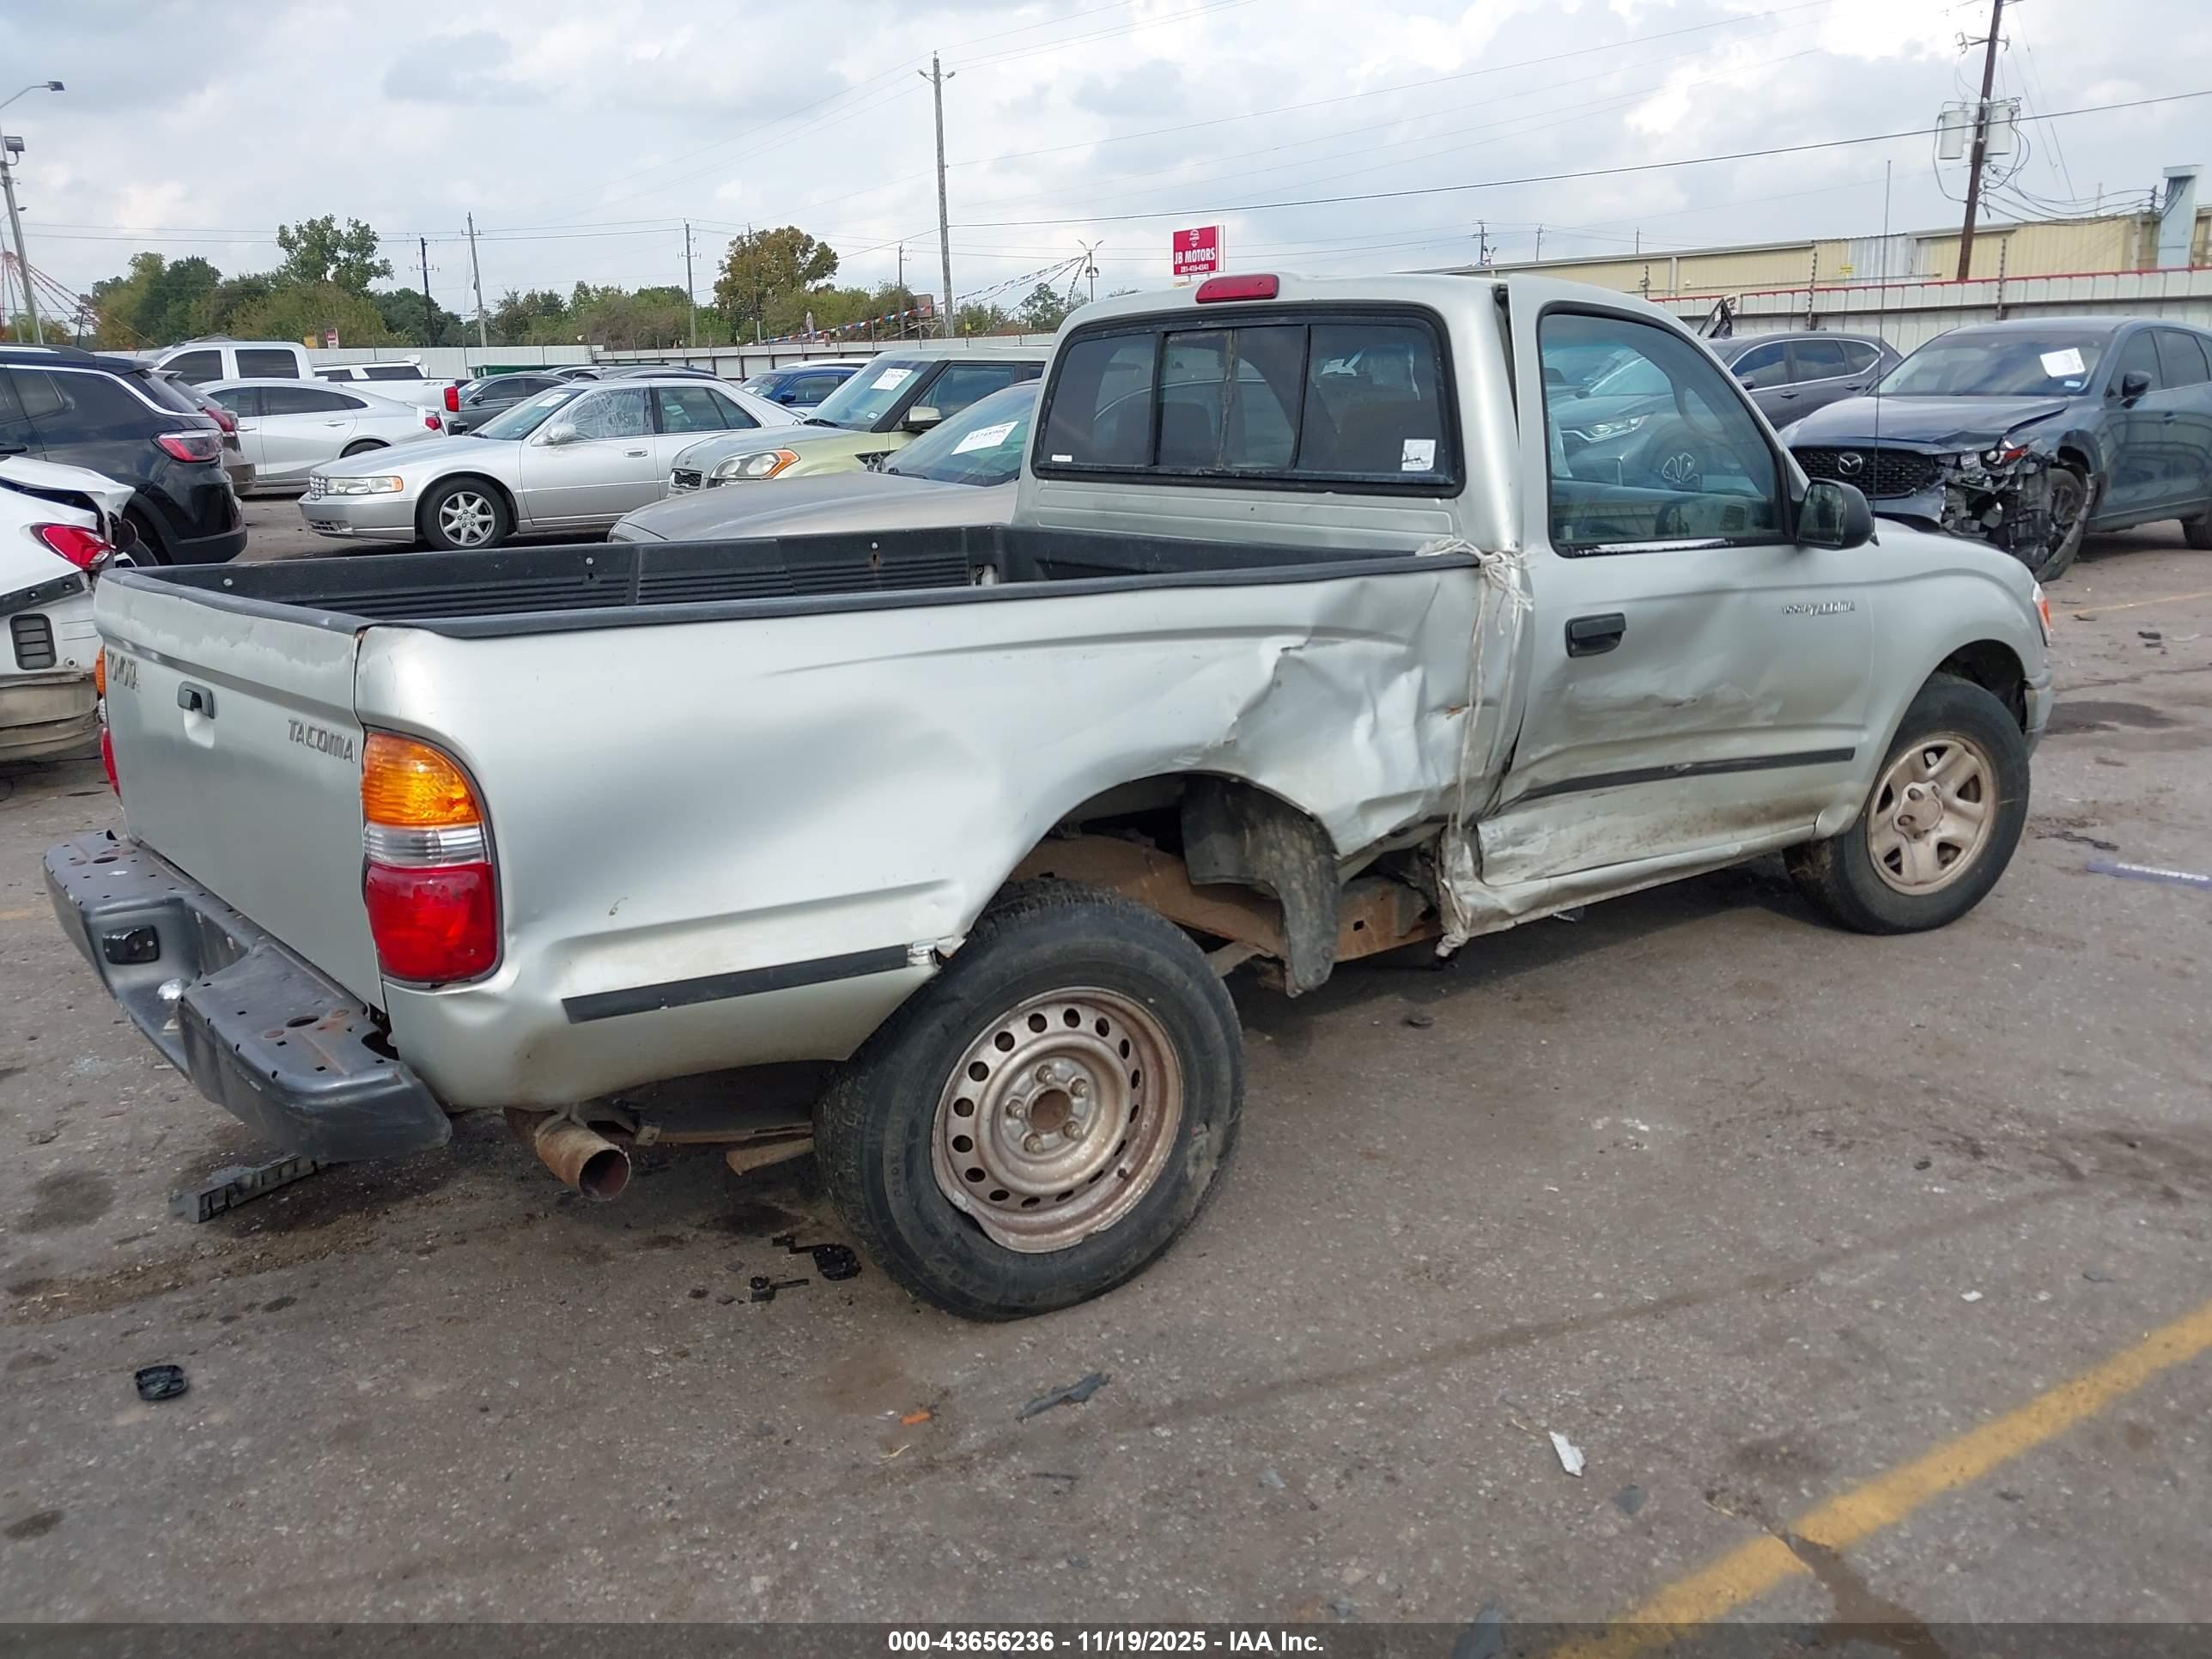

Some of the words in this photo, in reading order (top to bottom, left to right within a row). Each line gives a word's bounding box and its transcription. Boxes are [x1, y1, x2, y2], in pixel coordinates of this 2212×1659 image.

[1175, 252, 1183, 264] JB
[1184, 247, 1215, 264] MOTORS
[288, 718, 356, 763] TACOMA
